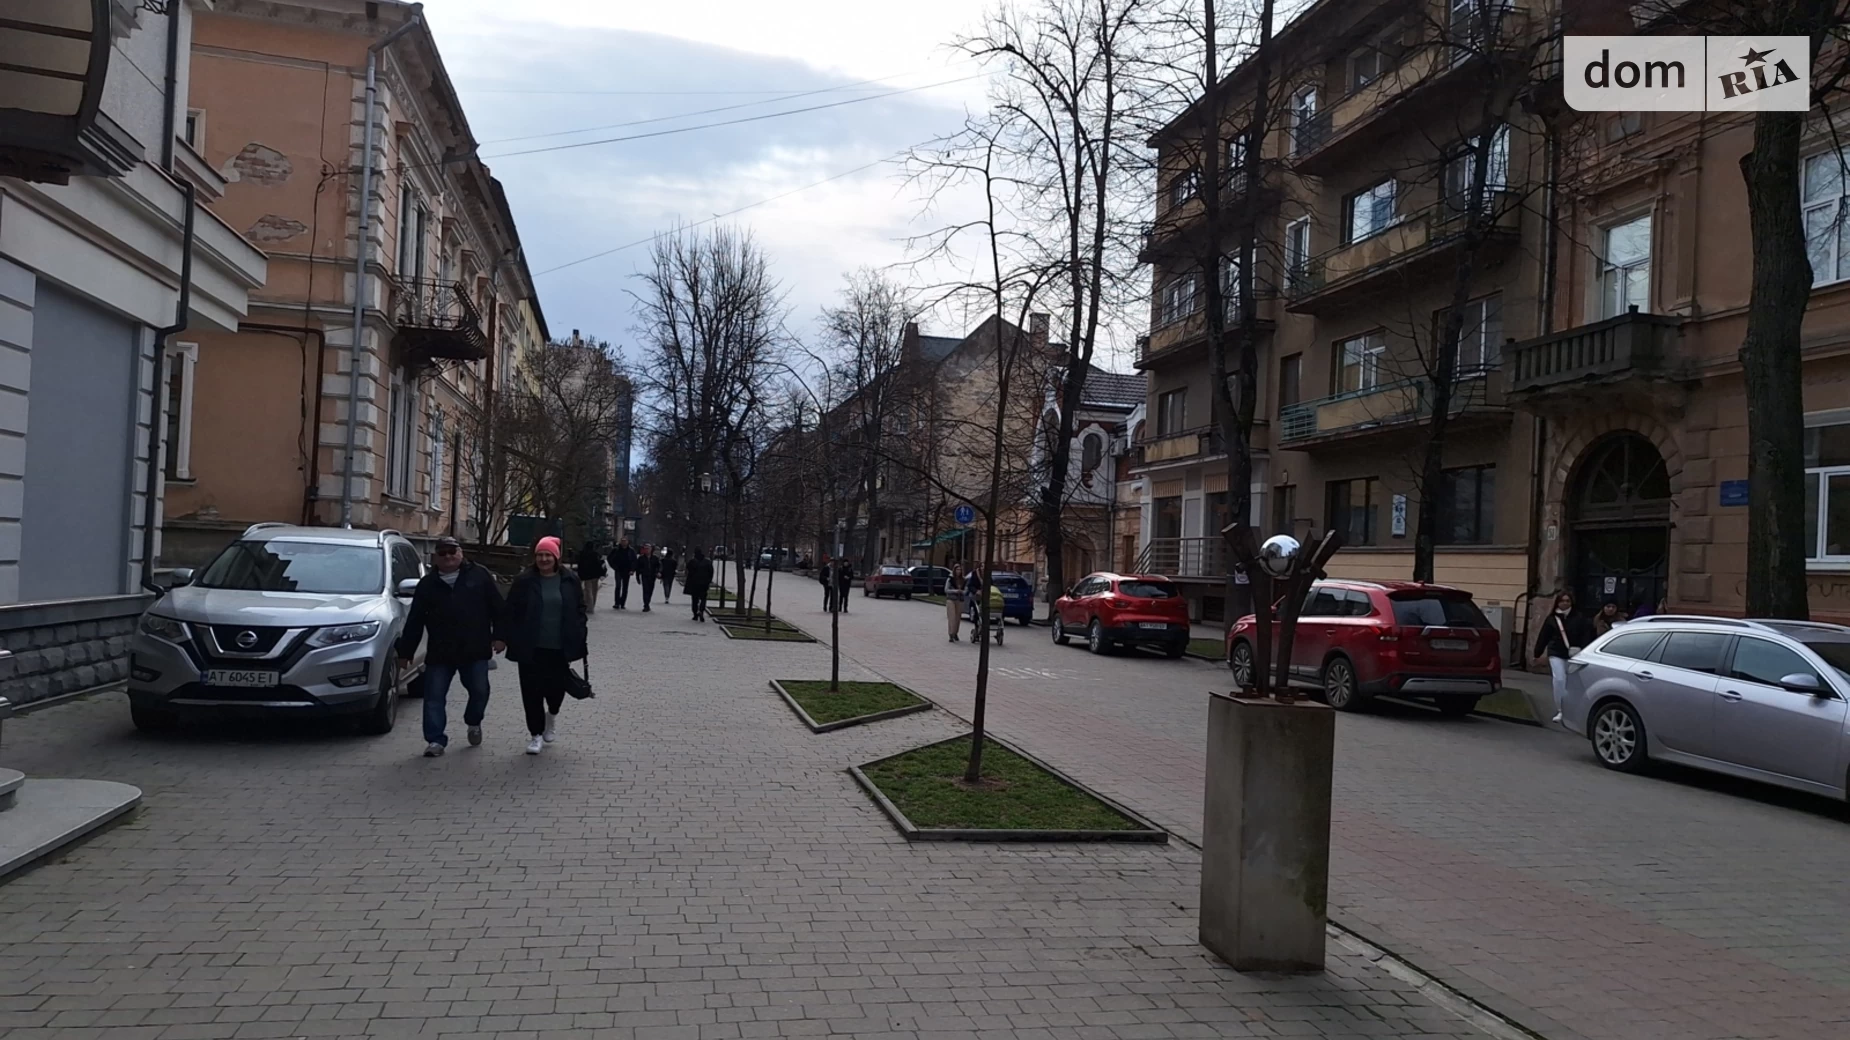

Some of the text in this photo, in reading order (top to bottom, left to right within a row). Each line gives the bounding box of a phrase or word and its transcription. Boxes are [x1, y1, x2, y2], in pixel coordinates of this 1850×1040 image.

[209, 671, 273, 684] AT 6045 EI
